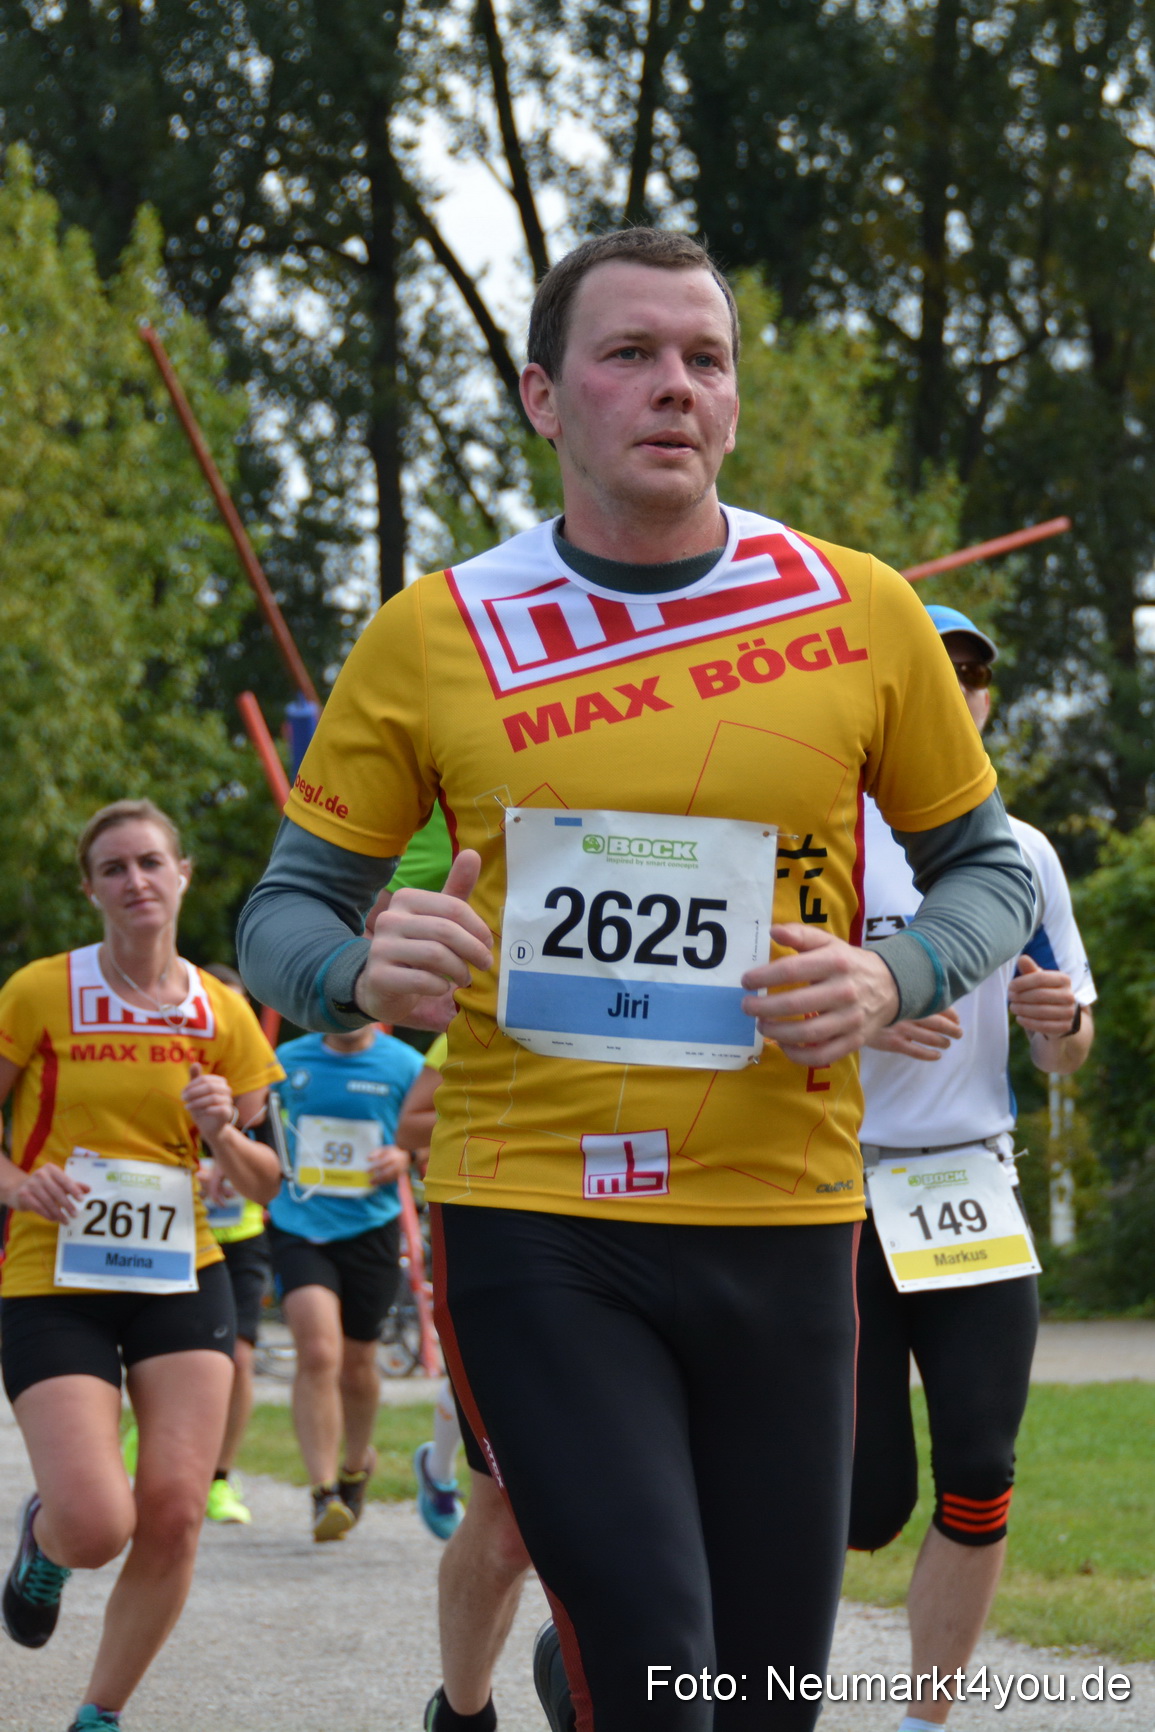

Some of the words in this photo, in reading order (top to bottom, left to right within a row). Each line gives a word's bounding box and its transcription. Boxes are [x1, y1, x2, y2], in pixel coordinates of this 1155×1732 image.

[502, 675, 674, 753] MAX
[688, 626, 869, 700] BÖGL
[607, 836, 698, 861] BOCK
[606, 856, 634, 865] inspired
[635, 857, 643, 866] by
[668, 862, 699, 870] concepts
[542, 886, 728, 970] 2625
[517, 946, 526, 959] D
[607, 992, 650, 1019] Jiri
[70, 1043, 138, 1062] MAX
[323, 1141, 353, 1166] 59
[83, 1199, 177, 1241] 2617
[909, 1199, 987, 1240] 149
[105, 1252, 153, 1269] Marina
[934, 1249, 988, 1266] Markus
